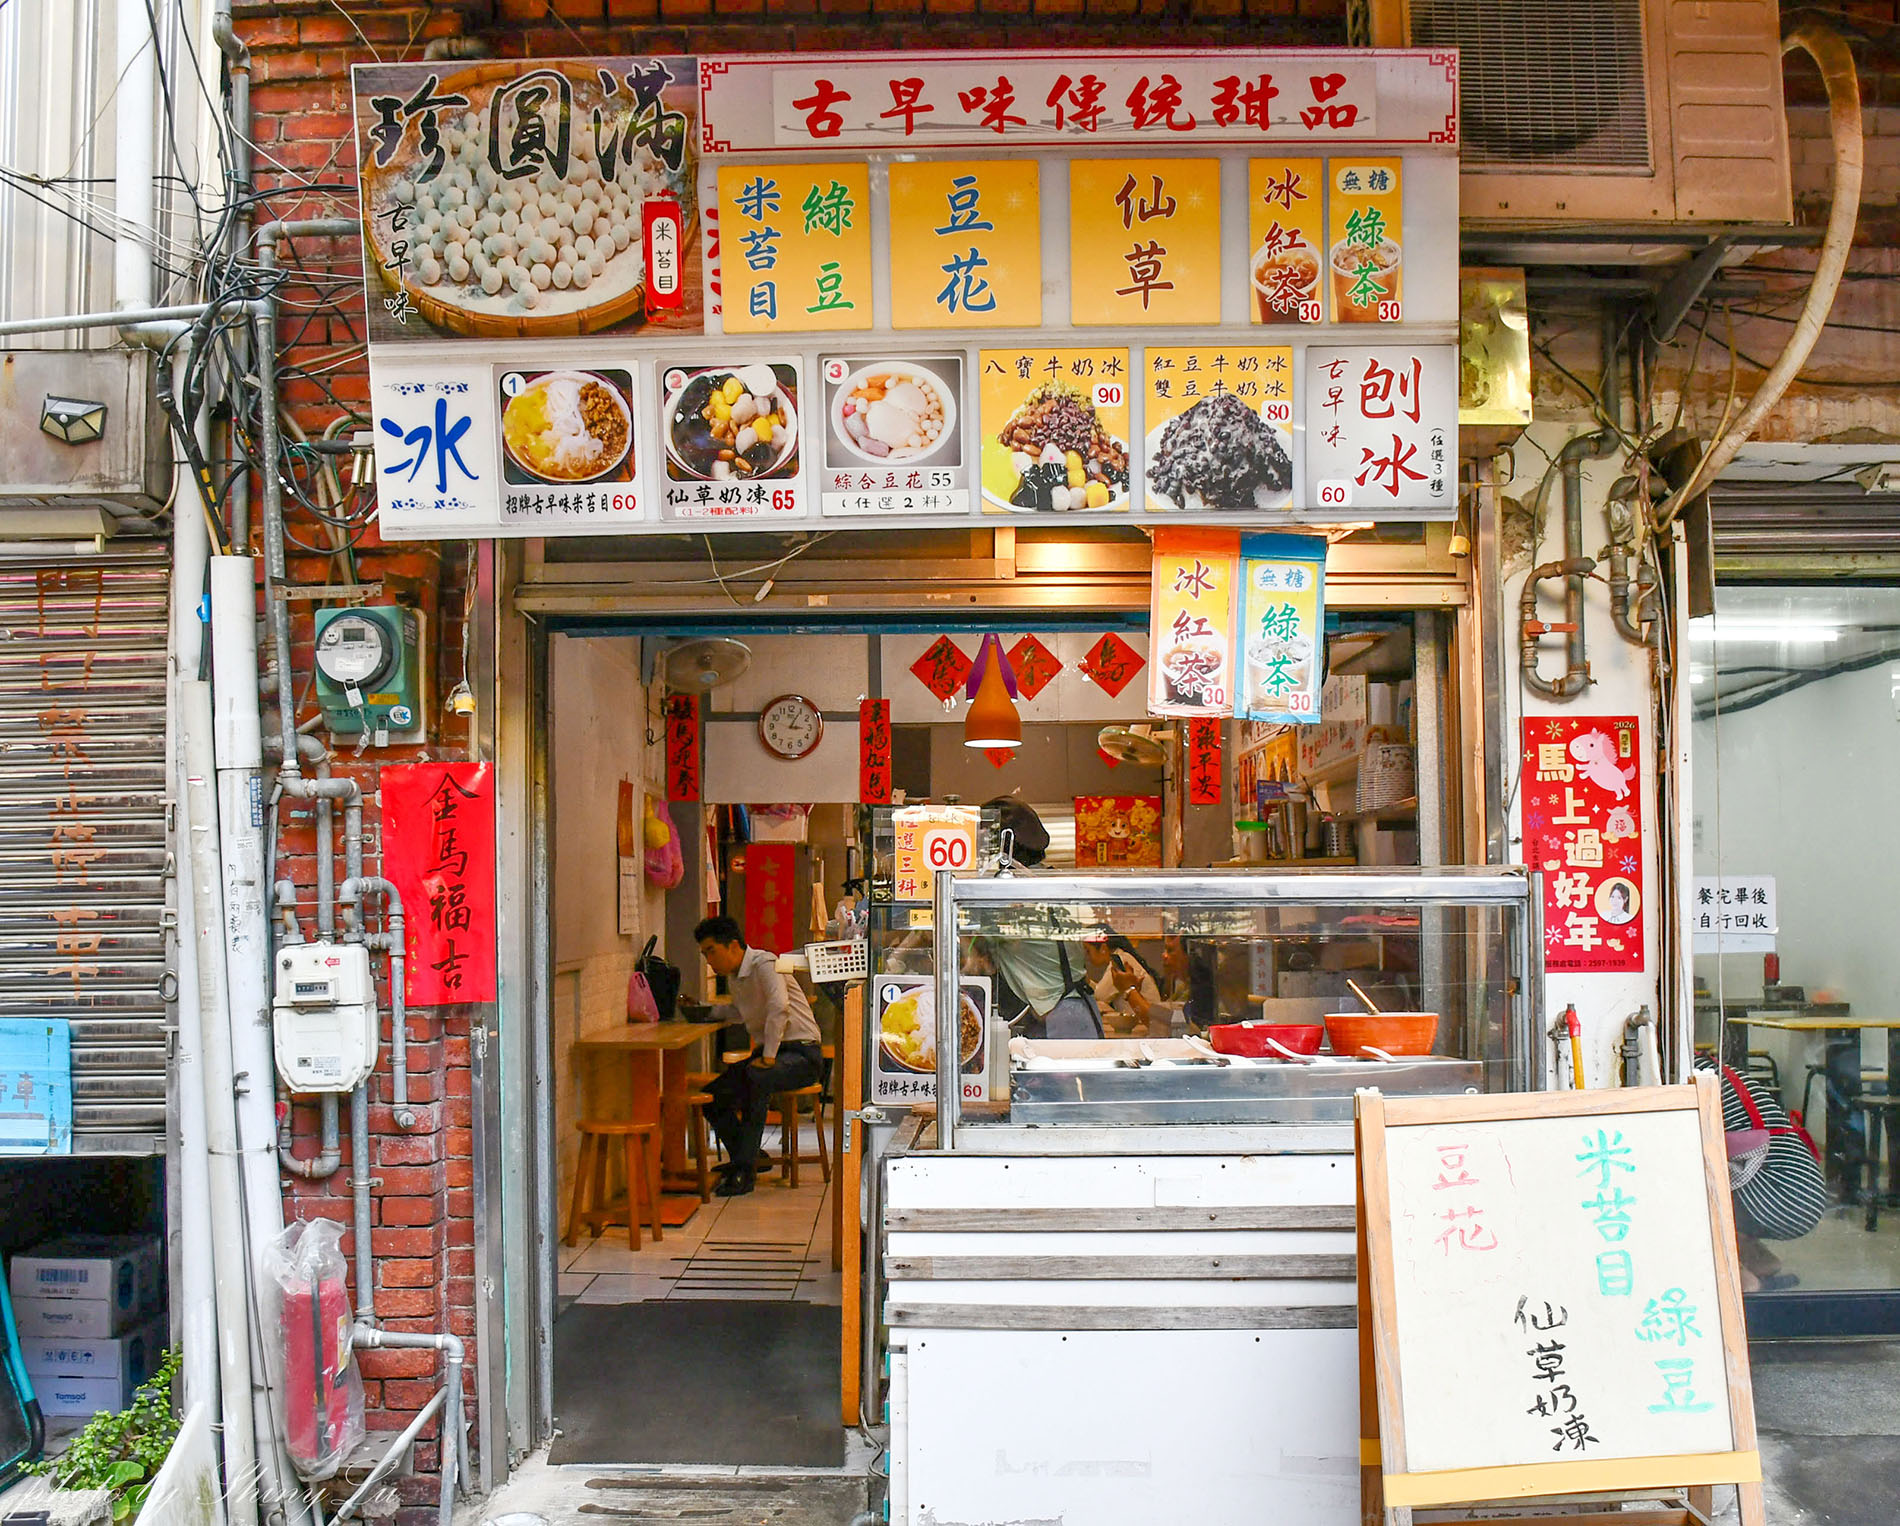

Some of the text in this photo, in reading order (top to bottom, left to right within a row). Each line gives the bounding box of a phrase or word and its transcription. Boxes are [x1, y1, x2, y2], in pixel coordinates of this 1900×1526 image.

[792, 73, 1358, 139] 古早味傳統甜品
[368, 60, 686, 184] 珍圓滿
[1341, 169, 1389, 192] 無糖
[655, 221, 674, 291] 米苔目
[734, 176, 782, 321] 米苔目
[801, 180, 855, 315] 綠豆
[934, 174, 998, 315] 豆花
[1114, 172, 1178, 312] 仙草
[1263, 167, 1309, 315] 冰紅茶
[377, 202, 418, 325] 古早味
[1343, 206, 1388, 309] 綠茶
[1300, 303, 1321, 322] 30
[1379, 301, 1400, 321] 30
[829, 363, 842, 379] 3
[984, 355, 1126, 379] 八寶牛奶冰
[1153, 354, 1289, 373] 紅豆牛奶冰
[507, 376, 518, 394] 1
[670, 373, 683, 389] 2
[1098, 386, 1121, 404] 90
[1154, 380, 1287, 399] 雙豆牛奶冰
[1267, 404, 1289, 421] 80
[1318, 358, 1349, 448] 古早味
[1354, 357, 1429, 498] 刨冰
[380, 397, 480, 495] 冰
[666, 483, 795, 511] 仙草奶凍 65
[834, 472, 952, 491] 綜合豆花 55
[1322, 486, 1345, 503] 60
[505, 493, 637, 516] 招牌古早味米苔目 60
[1259, 568, 1305, 589] 無糖
[1172, 559, 1216, 698] 冰紅茶
[1261, 602, 1301, 698] 綠茶
[1204, 687, 1225, 705] 30
[1290, 693, 1311, 711] 30
[1613, 721, 1636, 730] 2026
[1191, 718, 1222, 798] 報平安
[929, 837, 967, 868] 60
[1535, 742, 1604, 952] 馬上過好年
[422, 772, 481, 991] 金馬福吉
[1697, 887, 1769, 905] 餐完畢後
[887, 987, 895, 1001] 1
[963, 1084, 982, 1098] 60
[1431, 1143, 1499, 1257] 豆花
[1575, 1129, 1637, 1297] 米苔目
[1634, 1287, 1716, 1415] 綠豆
[1513, 1294, 1600, 1452] 仙草奶凍
